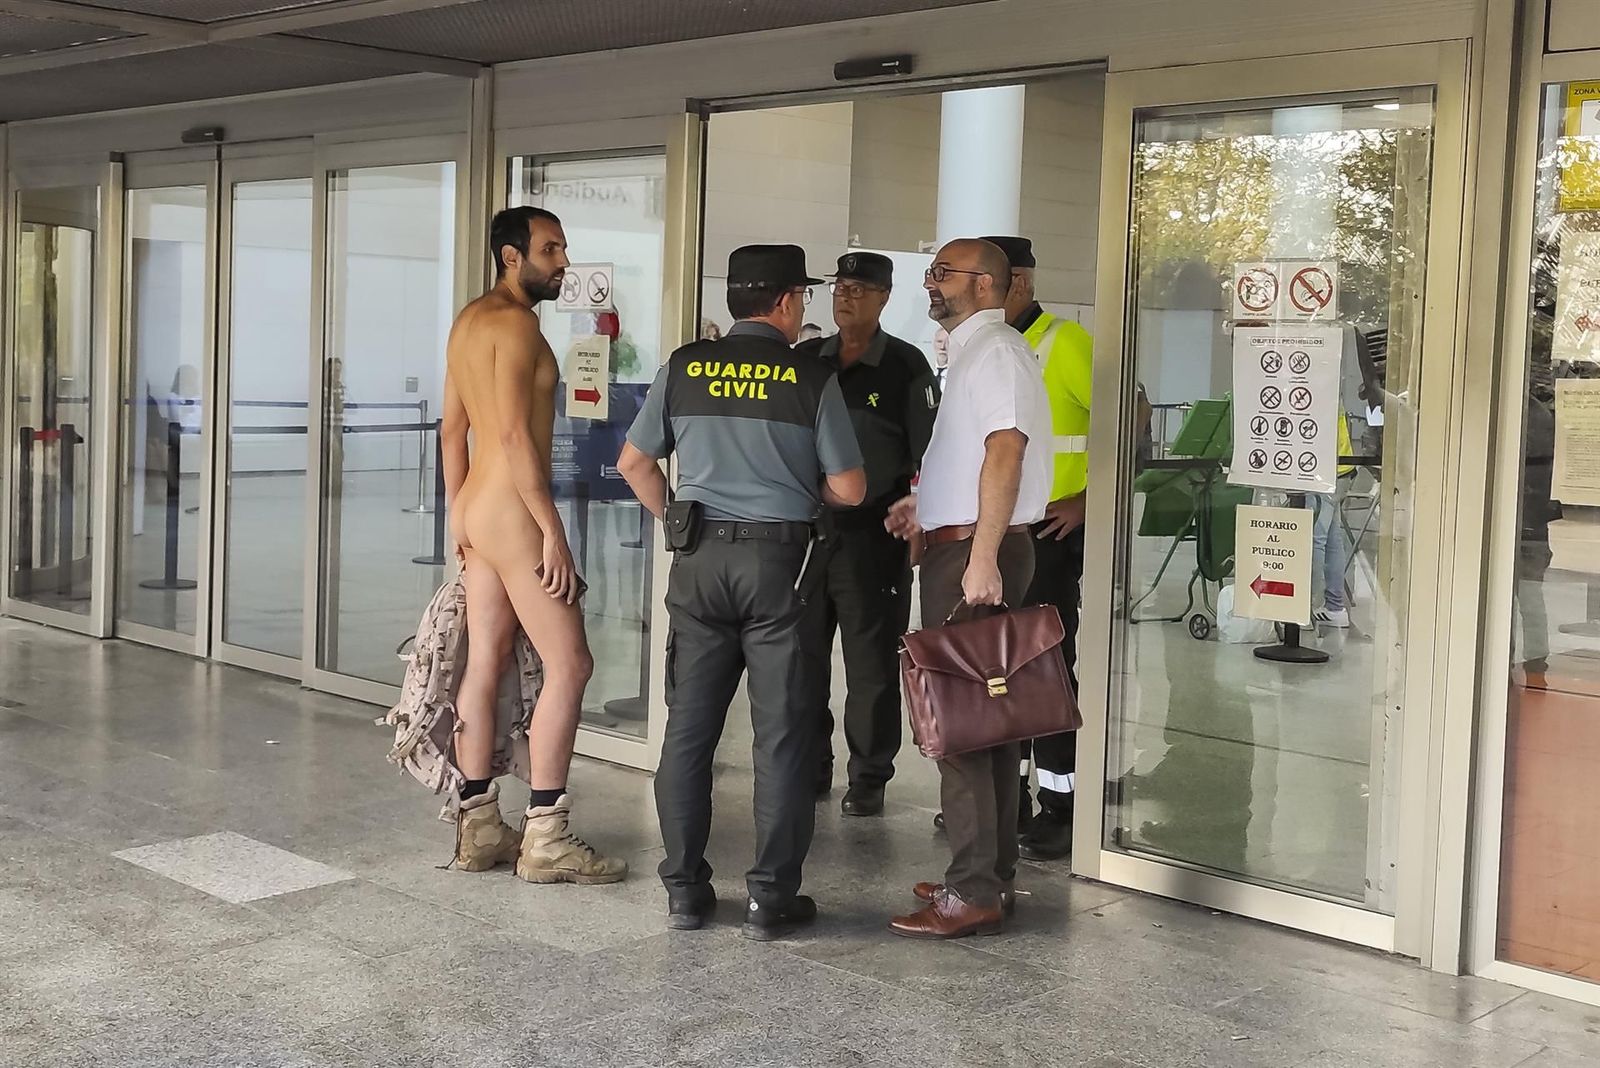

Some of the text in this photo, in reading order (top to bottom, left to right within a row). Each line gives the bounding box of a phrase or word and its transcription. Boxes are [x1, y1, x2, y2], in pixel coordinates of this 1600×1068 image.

[1574, 87, 1596, 95] ZONA
[686, 361, 797, 383] GUARDIA
[708, 380, 768, 400] CIVIL
[1250, 519, 1298, 531] HORARIO
[1266, 534, 1281, 543] AL
[1251, 546, 1296, 558] PUBLICO
[1262, 560, 1284, 571] 9:00
